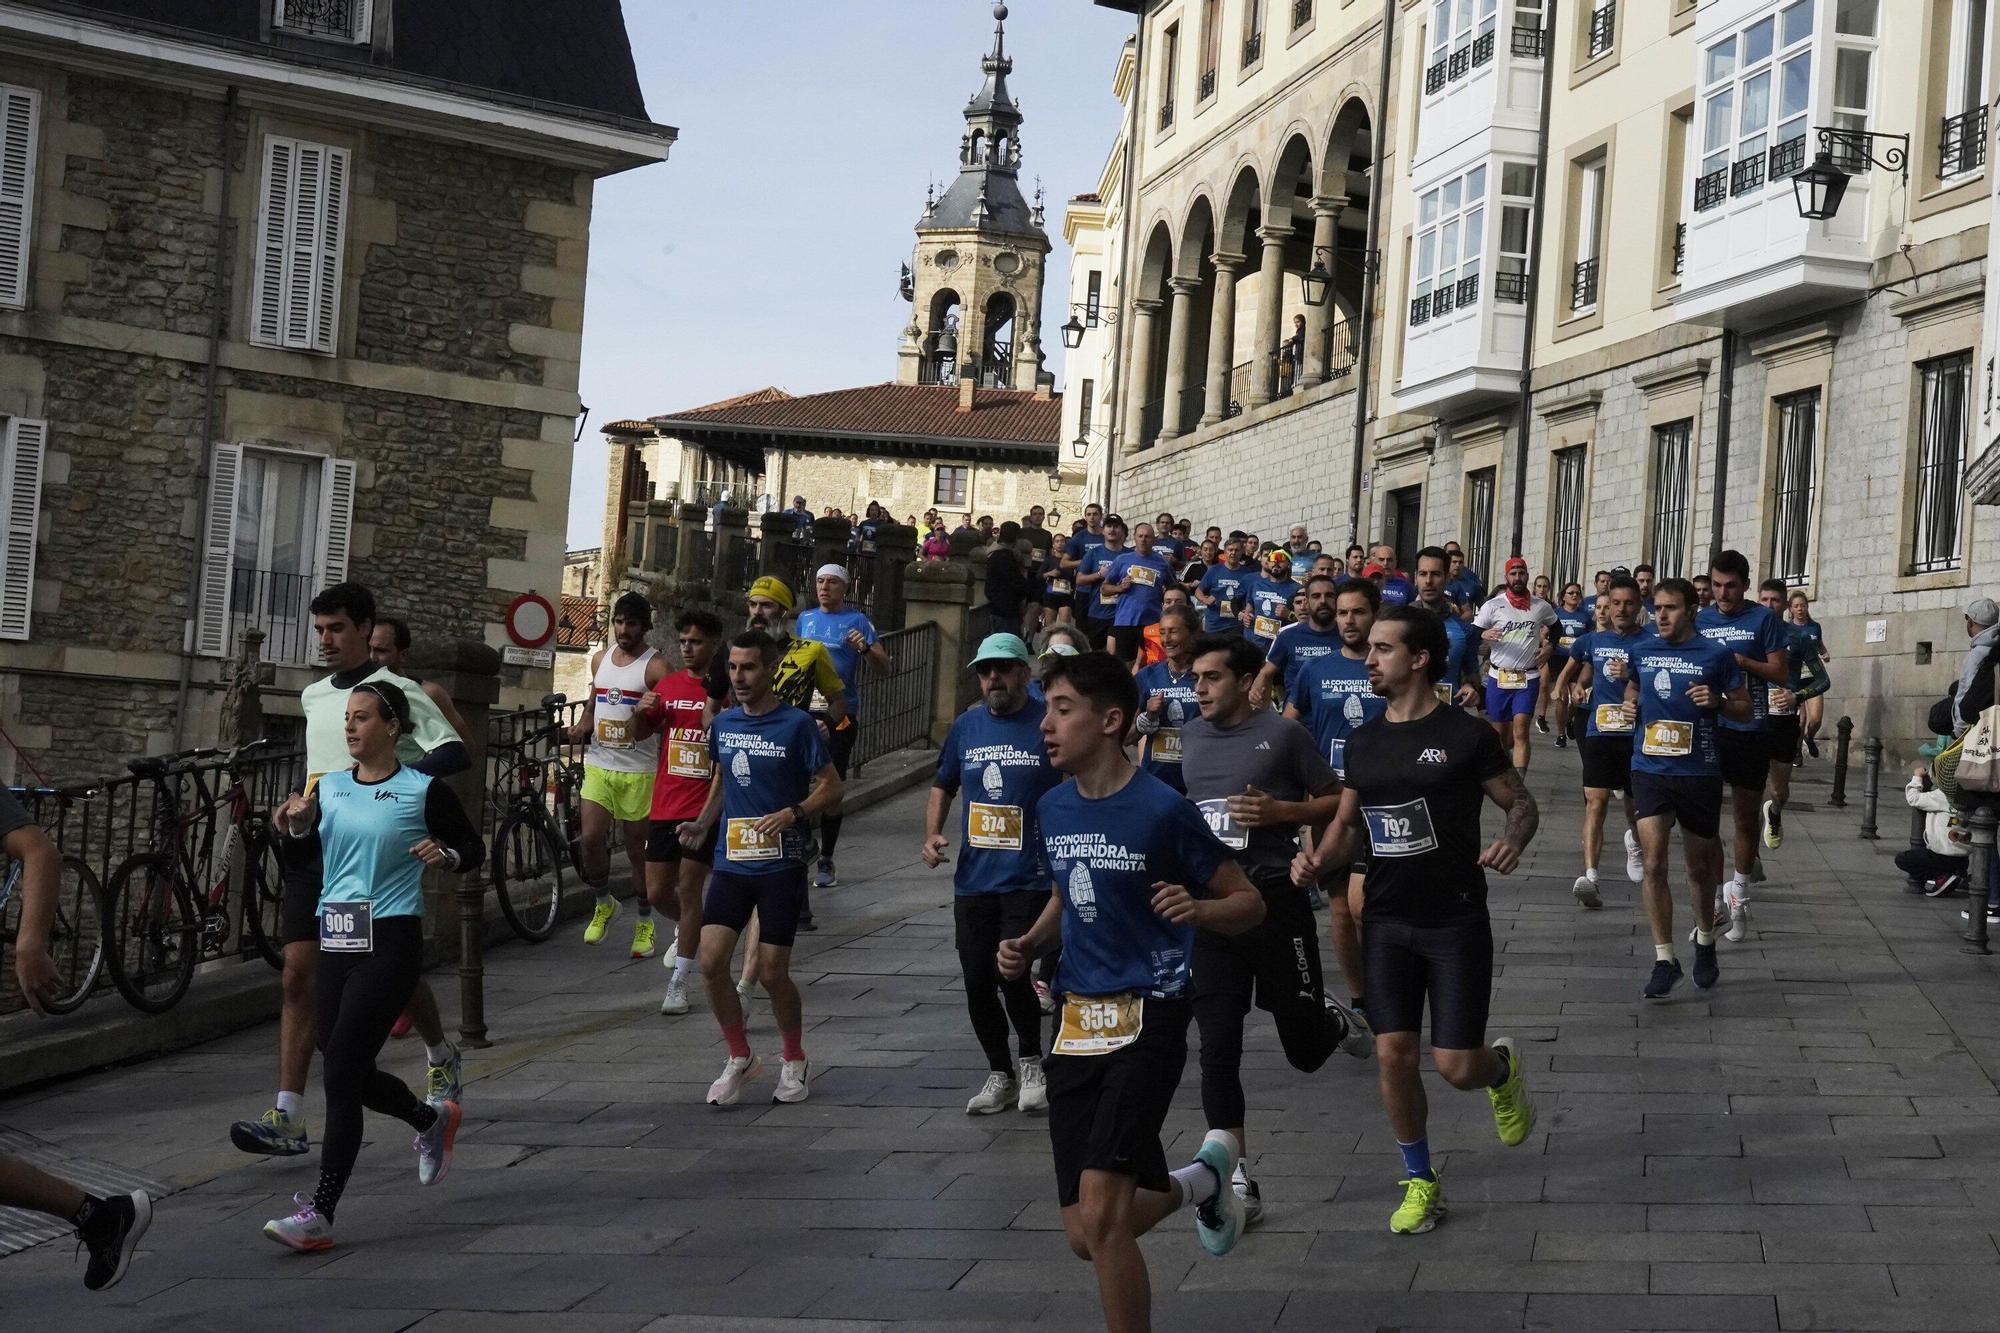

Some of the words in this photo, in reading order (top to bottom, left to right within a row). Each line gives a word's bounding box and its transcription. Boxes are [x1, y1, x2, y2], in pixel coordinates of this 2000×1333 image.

[1648, 661, 1694, 669] ALMENDRA
[666, 700, 705, 710] HEA
[605, 727, 625, 738] 539
[1655, 729, 1679, 743] 409
[725, 740, 775, 750] ALMENDRA
[973, 745, 1013, 754] CONQUISTA
[679, 751, 700, 764] 561
[749, 749, 786, 758] KONKISTA
[973, 751, 1029, 762] ALMENDRA
[982, 815, 1006, 832] 374
[1381, 818, 1412, 838] 792
[1046, 836, 1053, 846] LA
[1055, 833, 1106, 846] CONQUISTA
[1056, 844, 1128, 859] ALMENDRA
[1090, 858, 1146, 871] KONKISTA
[326, 914, 354, 932] 906
[1080, 1003, 1118, 1031] 355
